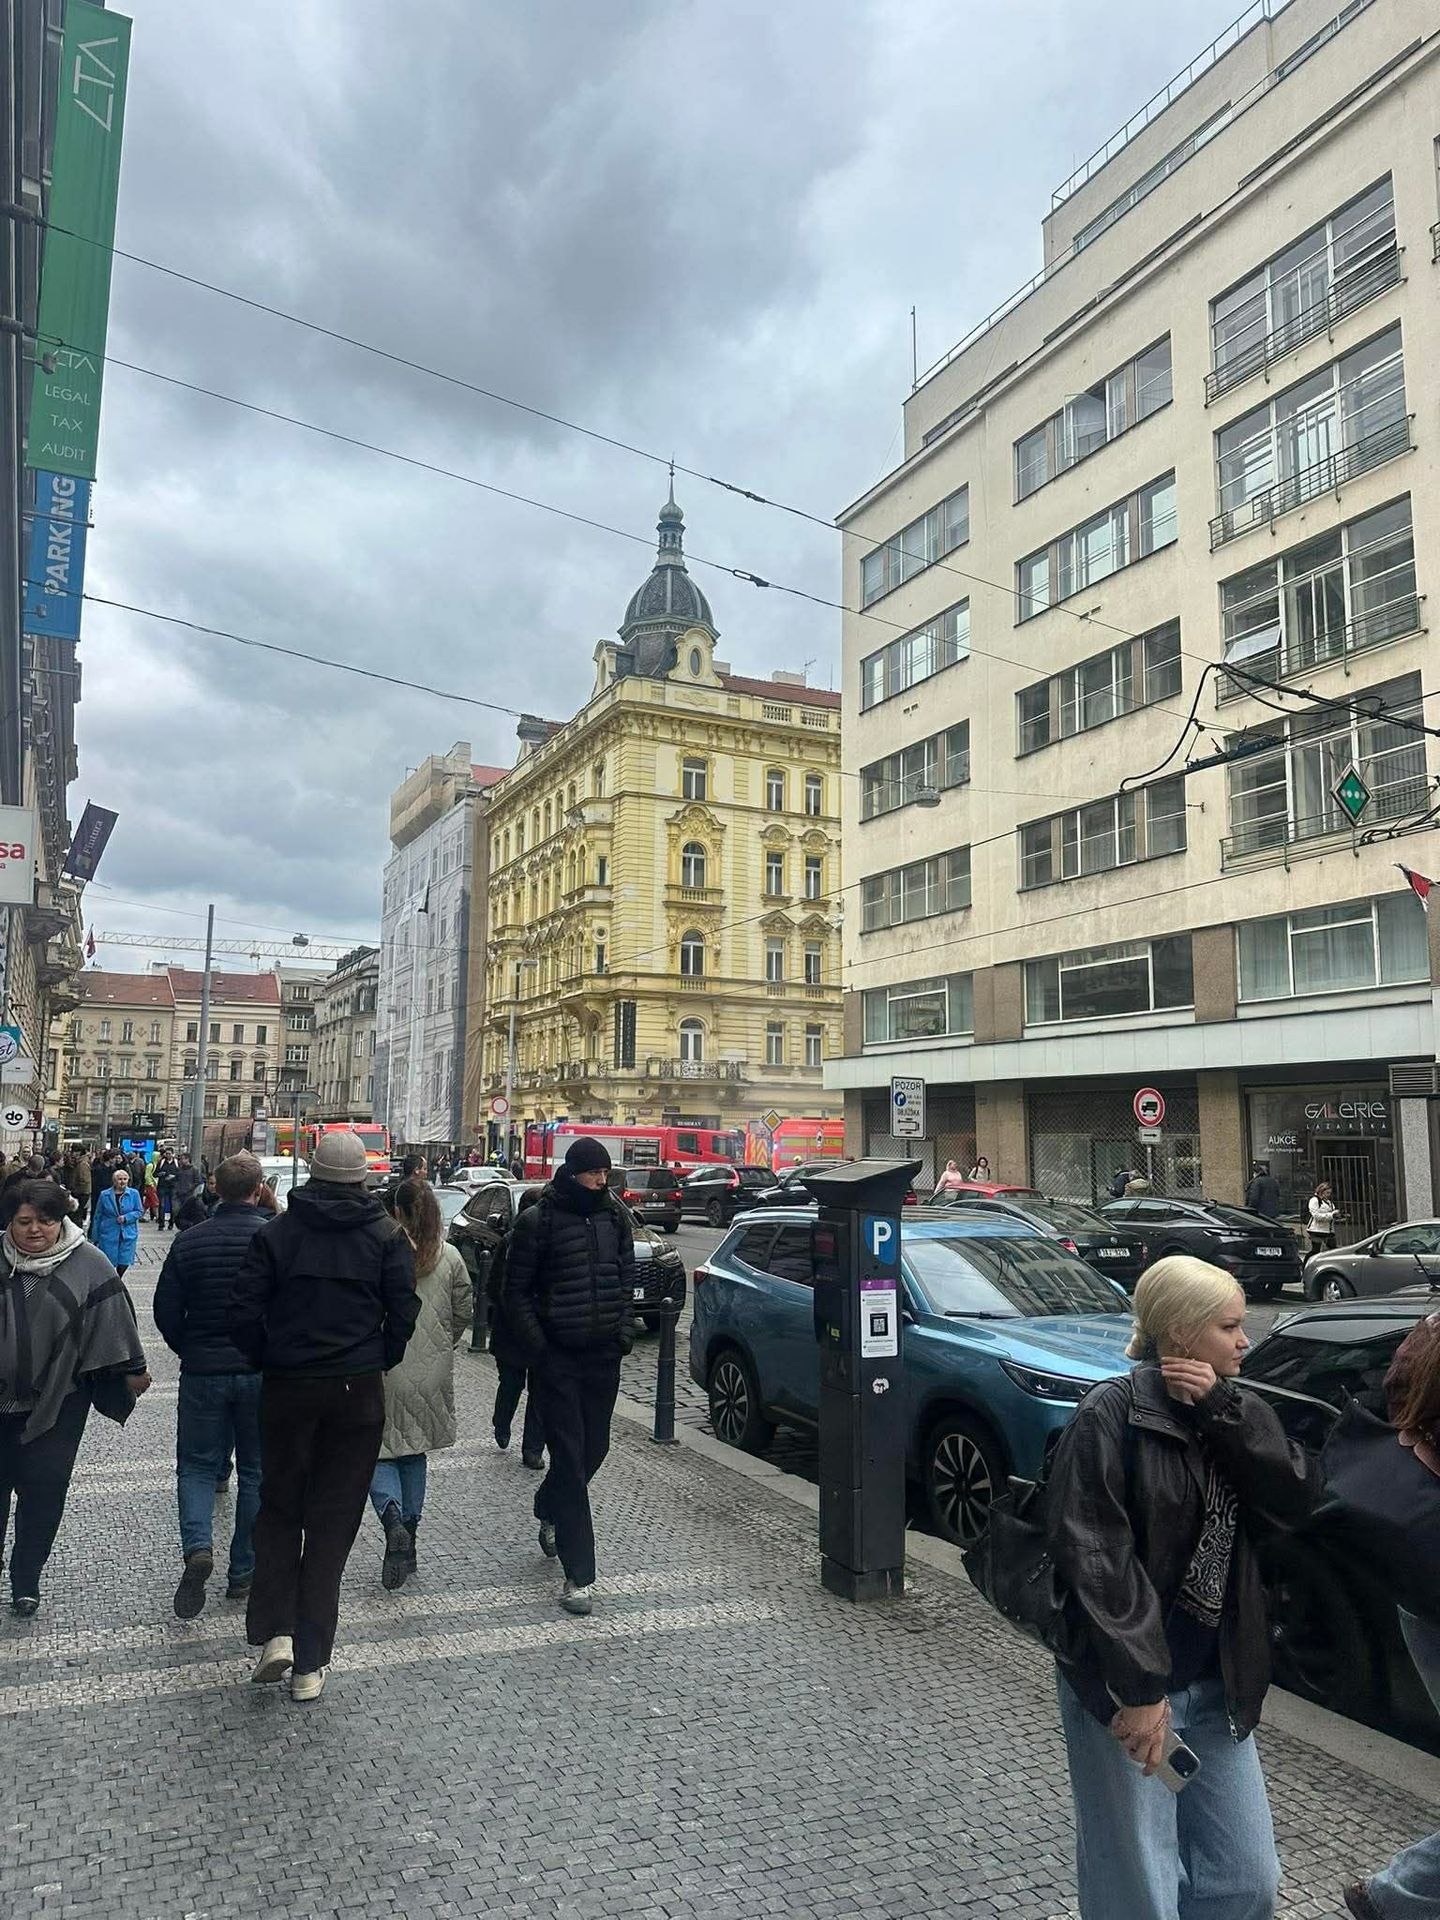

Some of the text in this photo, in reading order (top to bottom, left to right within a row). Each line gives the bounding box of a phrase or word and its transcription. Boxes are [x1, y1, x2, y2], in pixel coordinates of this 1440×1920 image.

[45, 384, 91, 406] LEGAL
[51, 414, 83, 433] TAX
[41, 442, 87, 461] AUDIT
[44, 476, 76, 598] PARKING
[895, 1081, 921, 1090] POZOR
[1268, 1136, 1297, 1145] AUKCE
[873, 1221, 892, 1255] P
